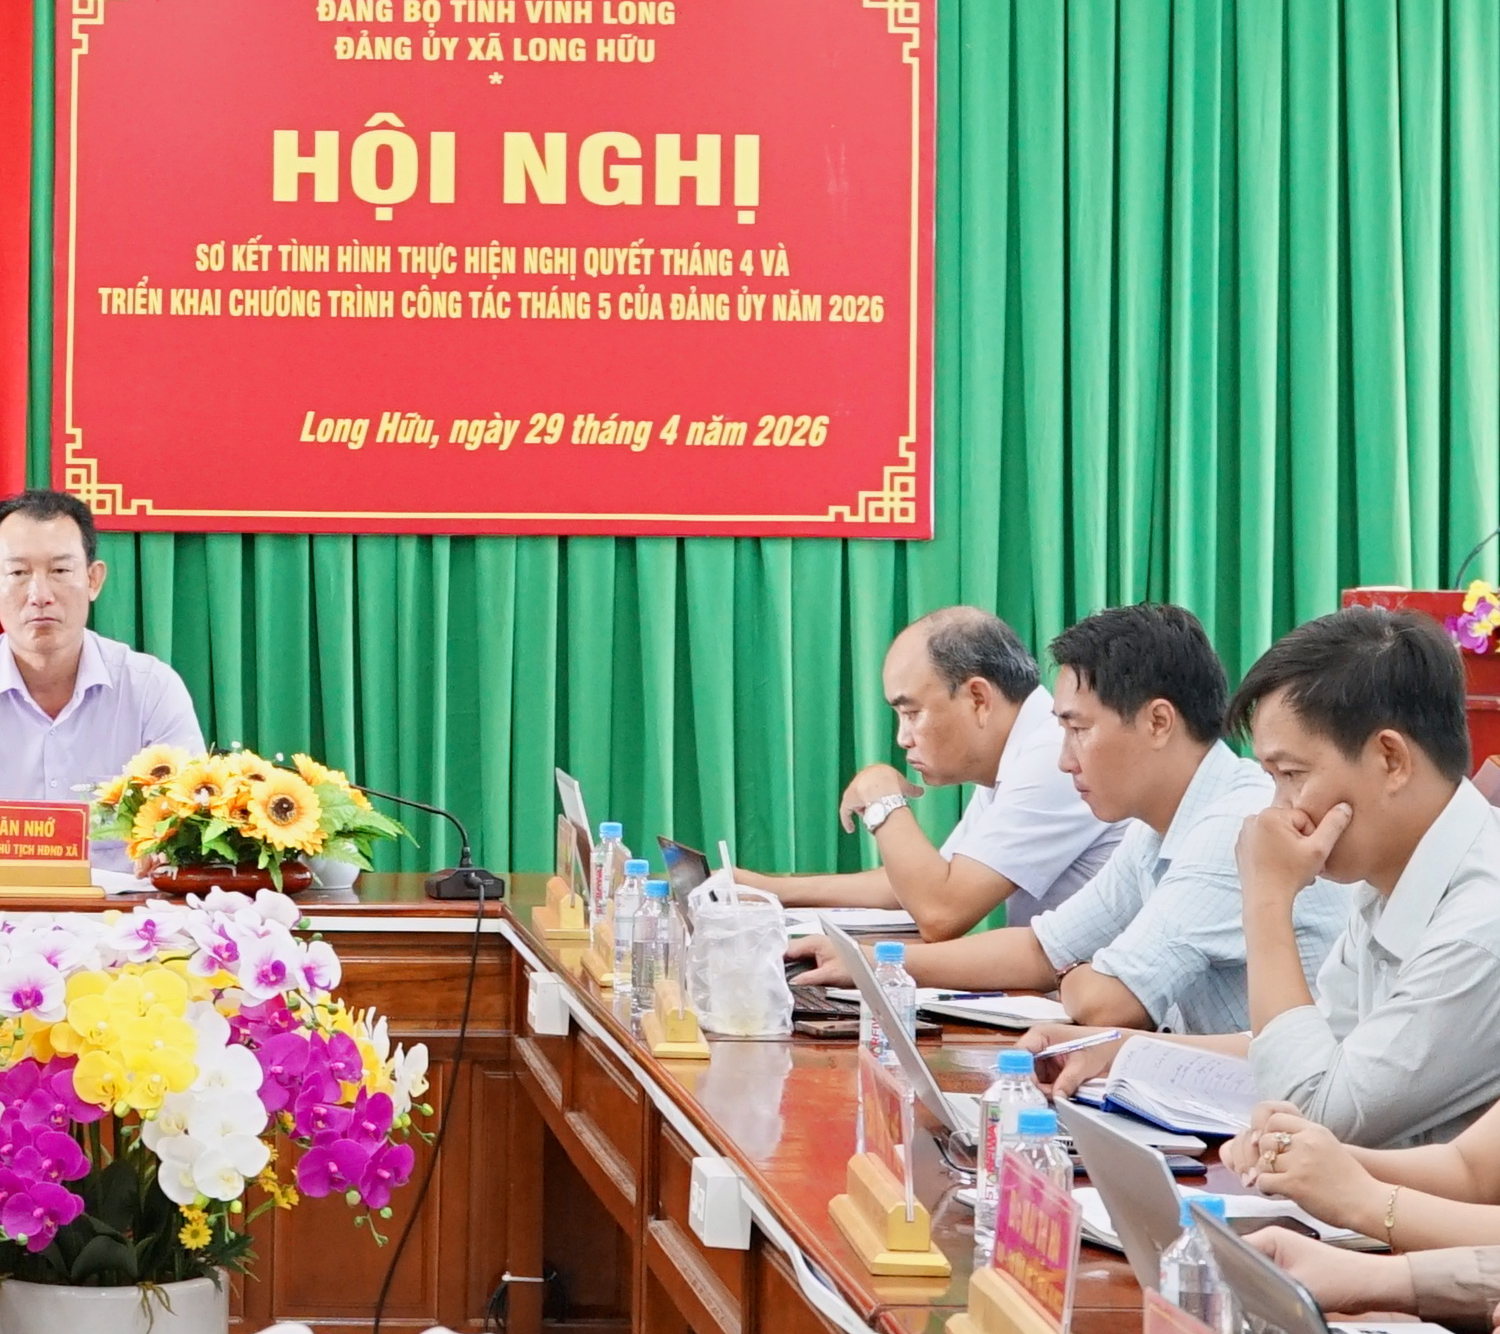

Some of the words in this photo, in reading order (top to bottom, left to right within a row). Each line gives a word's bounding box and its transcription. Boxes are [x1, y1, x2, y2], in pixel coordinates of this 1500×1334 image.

[603, 0, 676, 25] LONG
[335, 29, 412, 61] ĐẢNG
[422, 29, 459, 61] ỦY
[468, 33, 504, 61] XÃ
[513, 37, 587, 62] LONG
[597, 34, 656, 63] HỮU
[271, 111, 456, 221] HỘI
[502, 130, 762, 225] NGHỊ
[195, 241, 226, 273] SƠ
[232, 235, 273, 273] KẾT
[278, 238, 330, 273] TÌNH
[337, 239, 391, 274] HÌNH
[398, 242, 458, 280] THỰC
[464, 240, 516, 280] HIỆN
[523, 246, 577, 281] NGHỊ
[583, 238, 655, 276] QUYẾT
[660, 242, 733, 277] THÁNG
[739, 249, 754, 277] 4
[760, 242, 791, 277] VÀ
[98, 275, 163, 315] TRIỂN
[170, 288, 221, 316] KHAI
[228, 285, 321, 317] CHƯƠNG
[327, 284, 395, 318] TRÌNH
[401, 284, 462, 318] CÔNG
[468, 285, 511, 319] TÁC
[518, 285, 591, 320] THÁNG
[597, 292, 612, 320] 5
[618, 284, 664, 320] CỦA
[669, 285, 730, 322] ĐẢNG
[737, 285, 766, 322] ỦY
[772, 289, 822, 322] NĂM
[828, 295, 884, 323] 2026
[299, 410, 370, 450] Long
[375, 411, 440, 449] Hữu,
[448, 412, 521, 451] ngày
[524, 412, 565, 444] 29
[571, 412, 653, 453] tháng
[659, 414, 681, 445] 4
[685, 414, 748, 447] năm
[752, 415, 830, 447] 2026
[24, 817, 56, 838] NHỚ
[13, 845, 35, 857] TỊCH
[65, 843, 78, 857] XÃ
